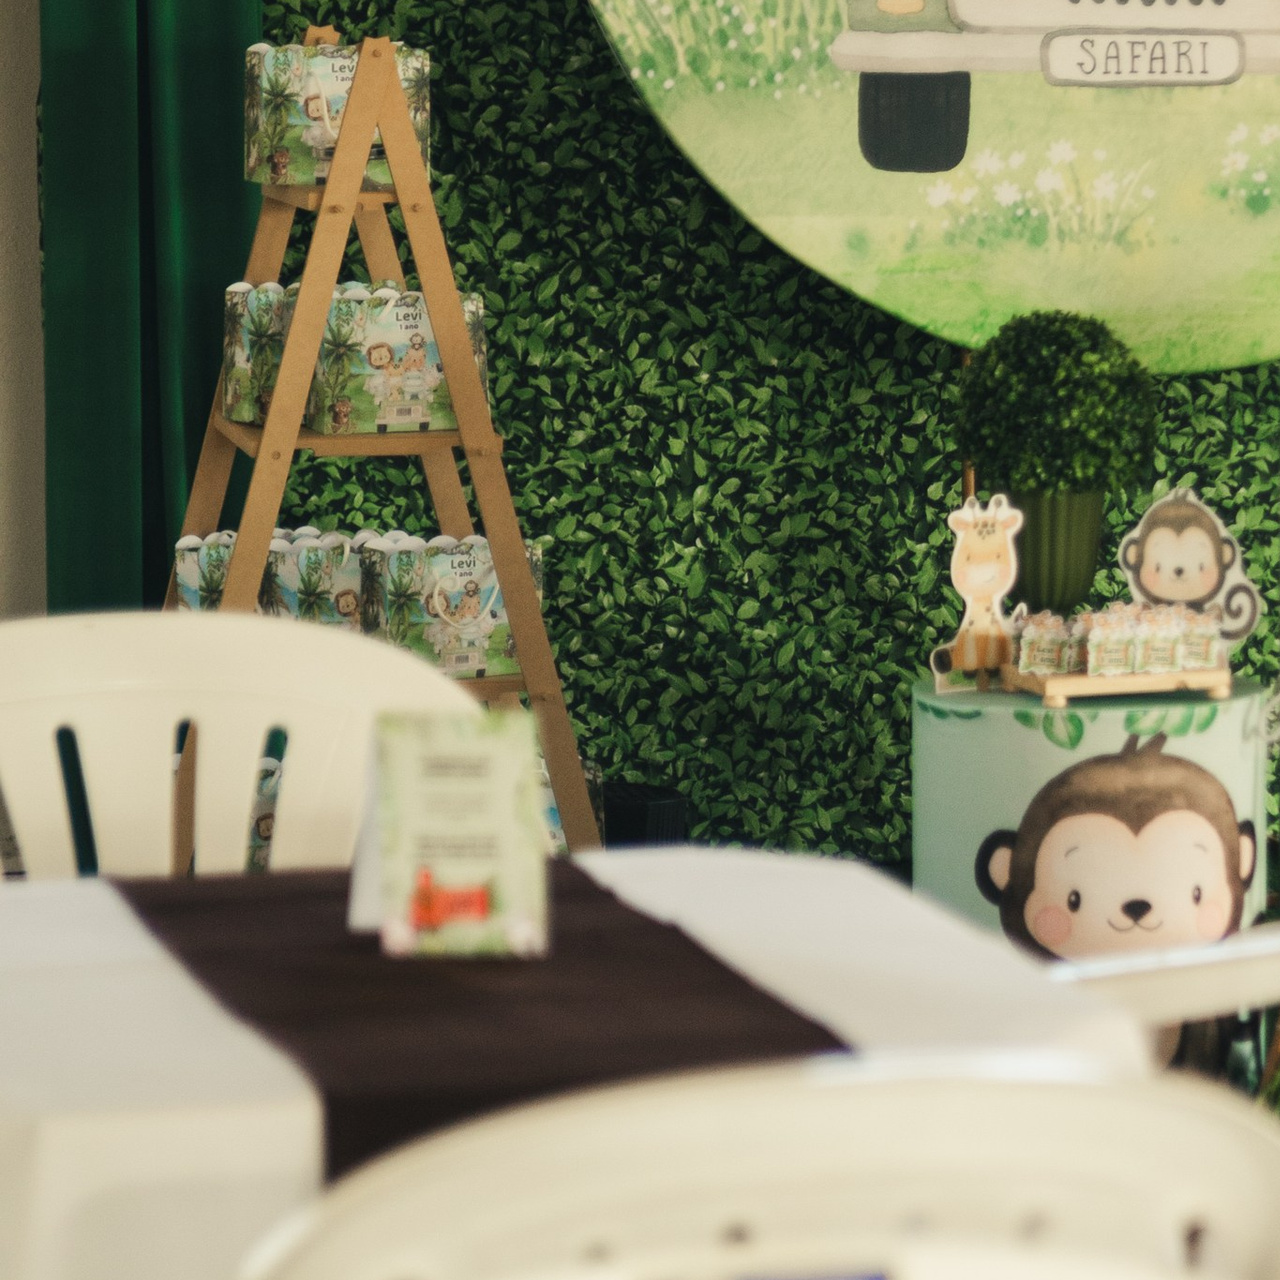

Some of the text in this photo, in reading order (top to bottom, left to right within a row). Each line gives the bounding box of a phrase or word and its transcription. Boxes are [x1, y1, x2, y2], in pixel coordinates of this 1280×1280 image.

[1077, 39, 1209, 75] SAFARI
[331, 63, 355, 73] Lev
[396, 309, 422, 321] Levi
[451, 556, 476, 569] Levi
